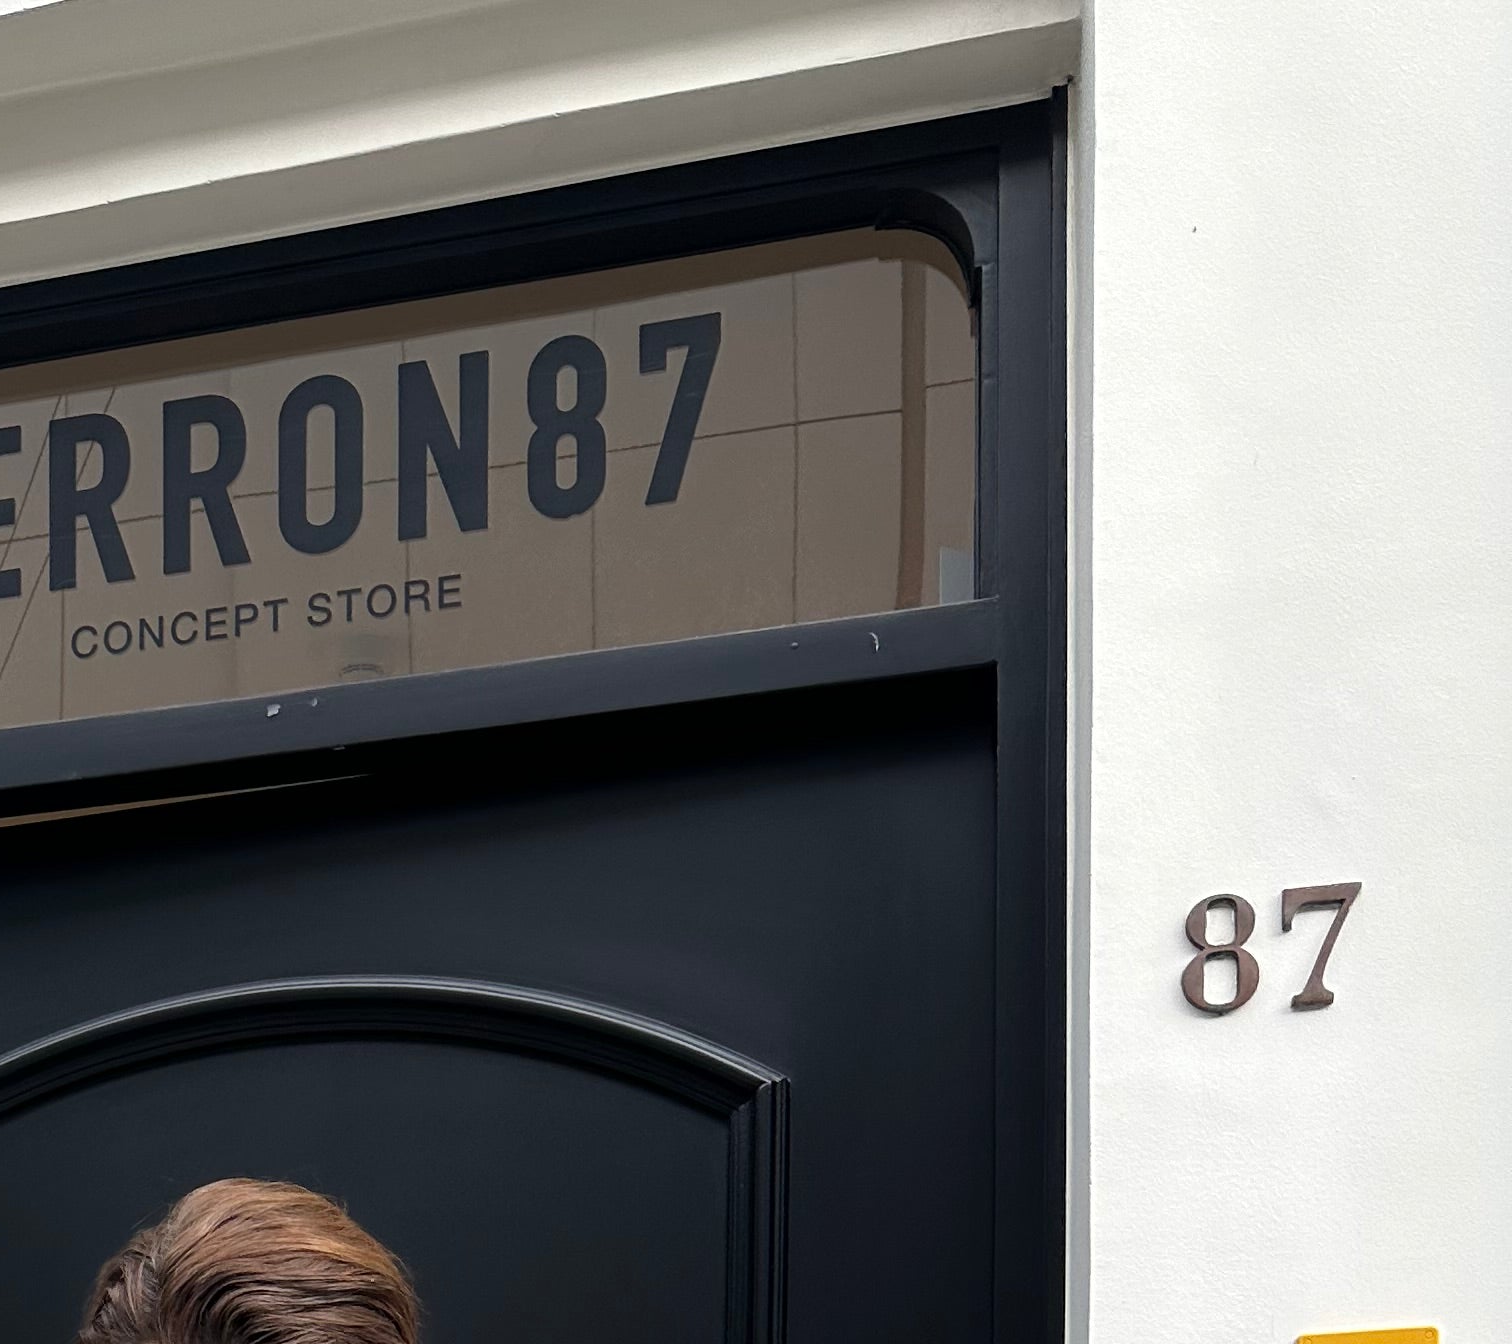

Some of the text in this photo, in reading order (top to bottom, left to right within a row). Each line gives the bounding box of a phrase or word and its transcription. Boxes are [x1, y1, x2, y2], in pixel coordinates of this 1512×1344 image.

[71, 574, 463, 660] CONCEPT STORE
[1181, 881, 1363, 1015] 87
